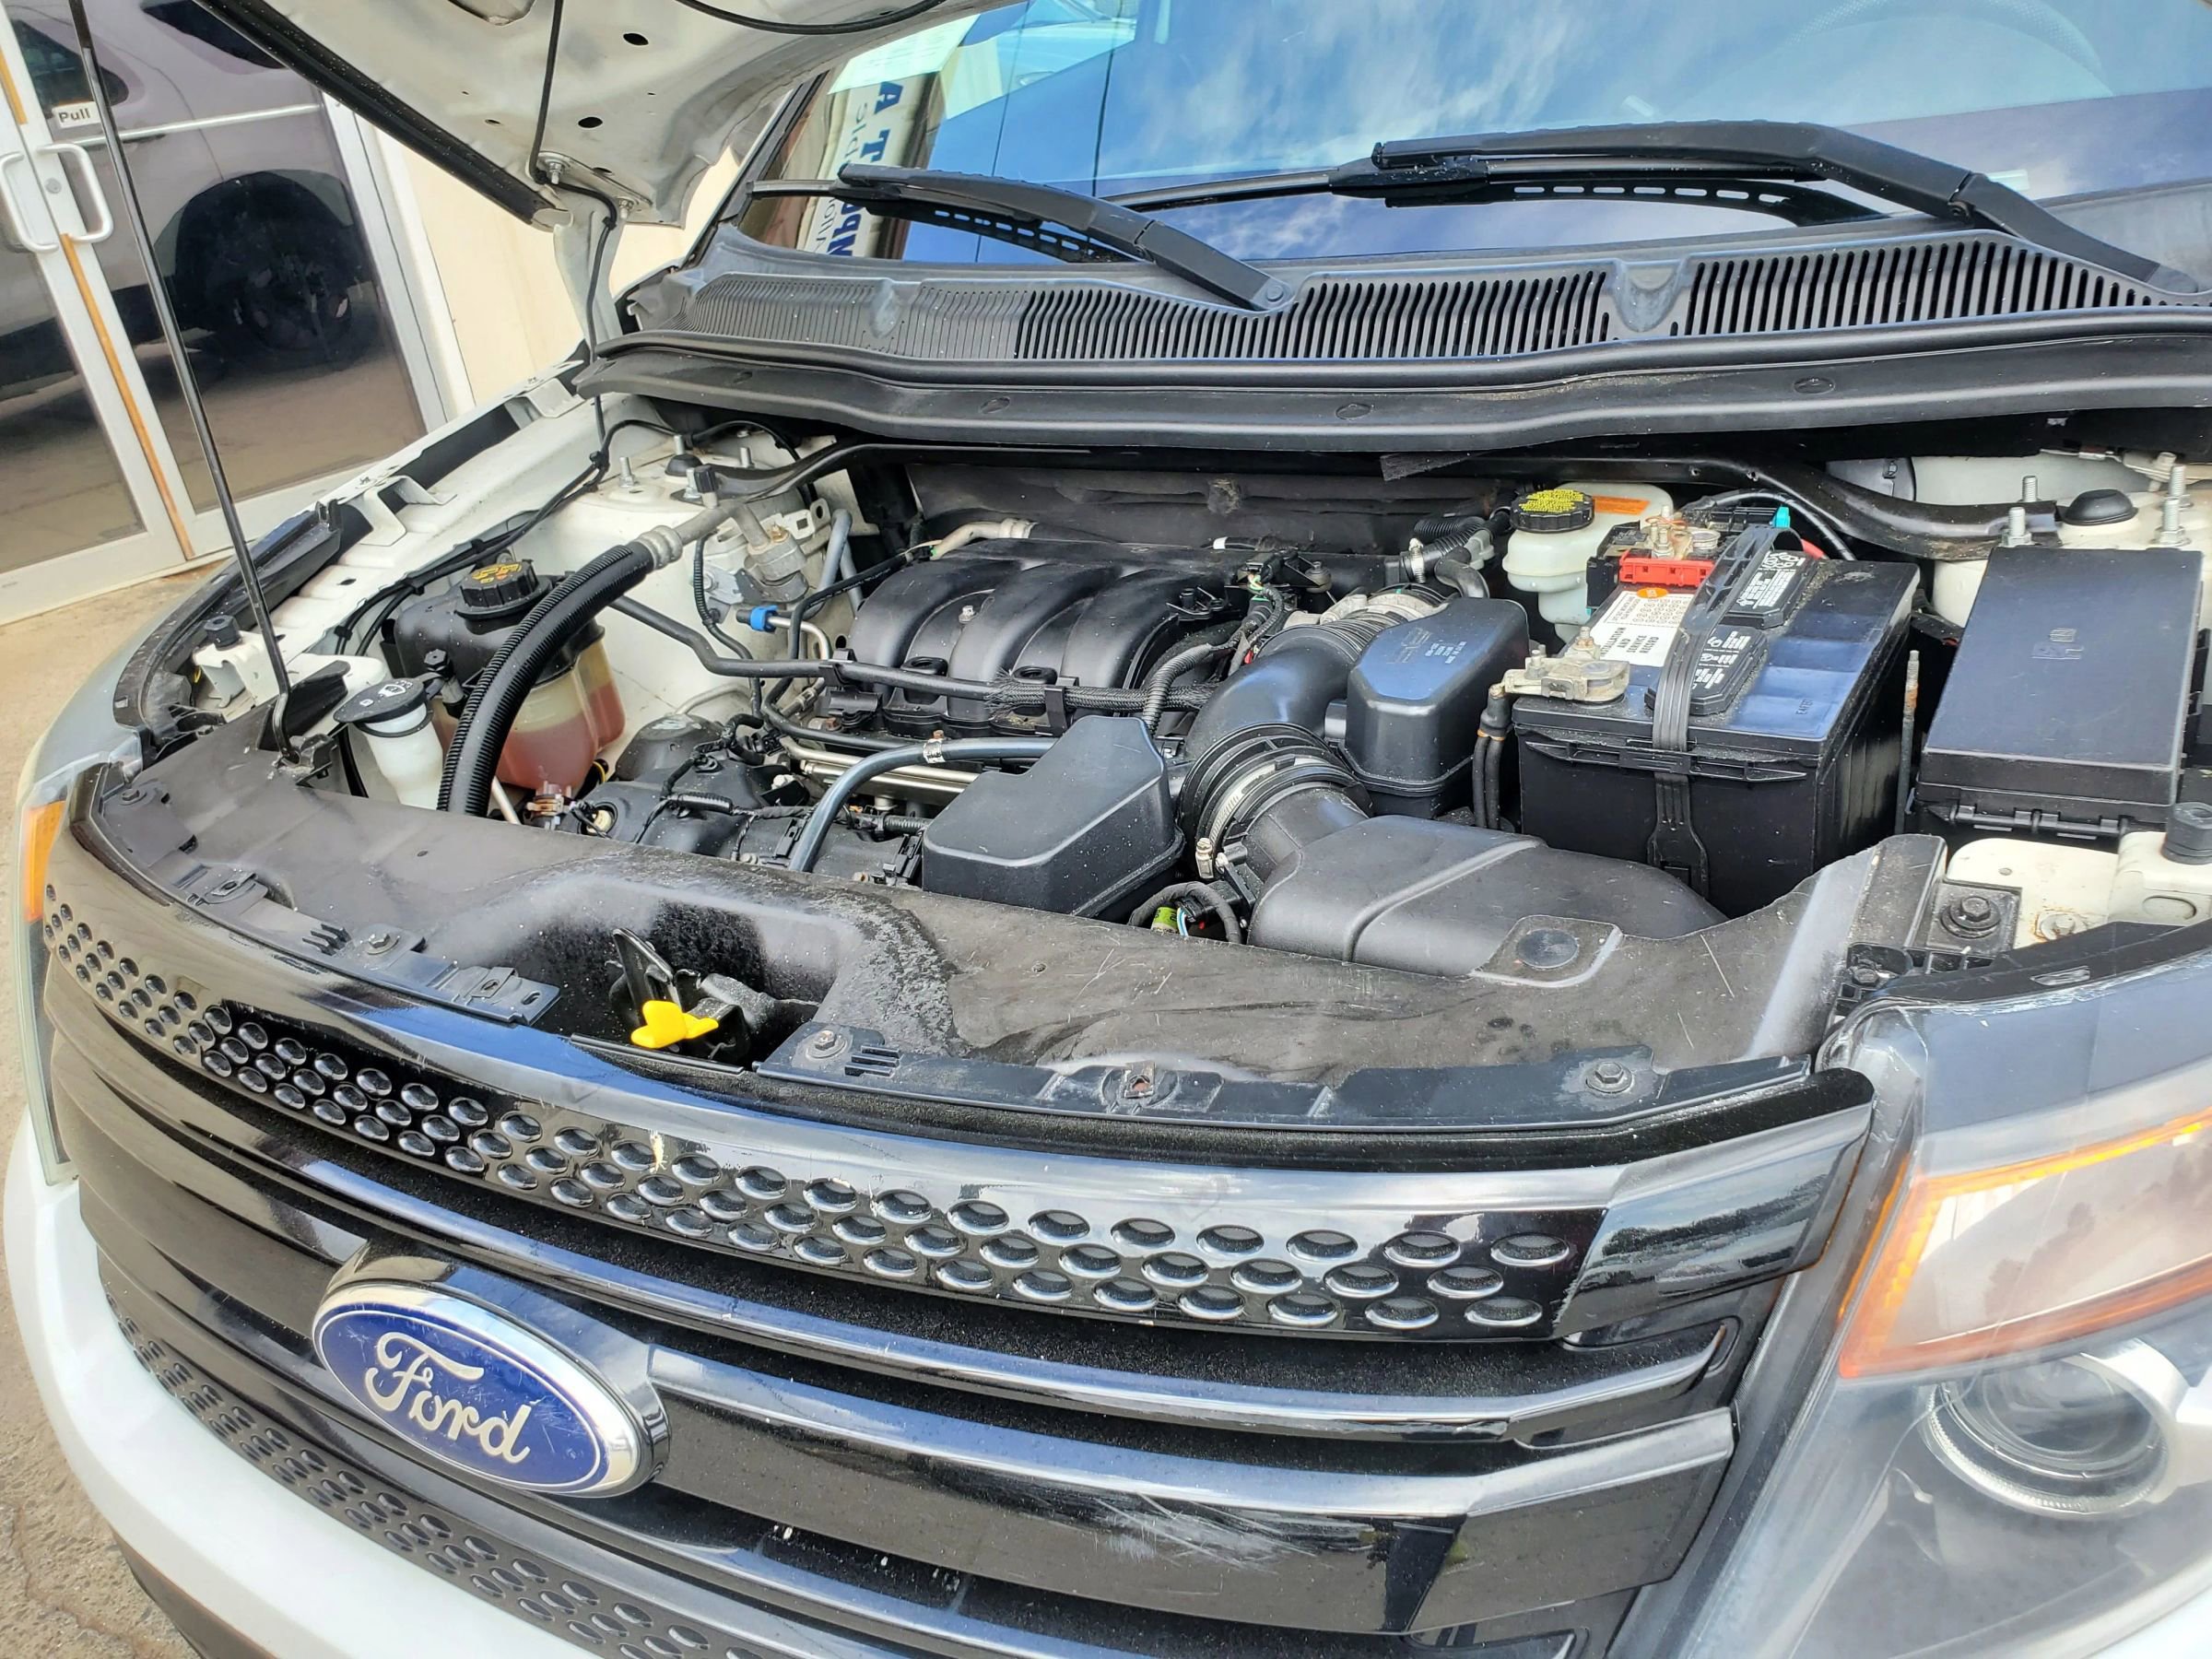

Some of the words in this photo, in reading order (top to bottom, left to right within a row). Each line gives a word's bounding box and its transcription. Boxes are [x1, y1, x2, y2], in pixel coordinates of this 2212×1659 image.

[58, 108, 91, 123] Pull
[1616, 638, 1630, 648] AND
[1626, 635, 1648, 653] SERVICE
[1639, 636, 1659, 653] RECORD
[365, 1331, 532, 1464] Ford
